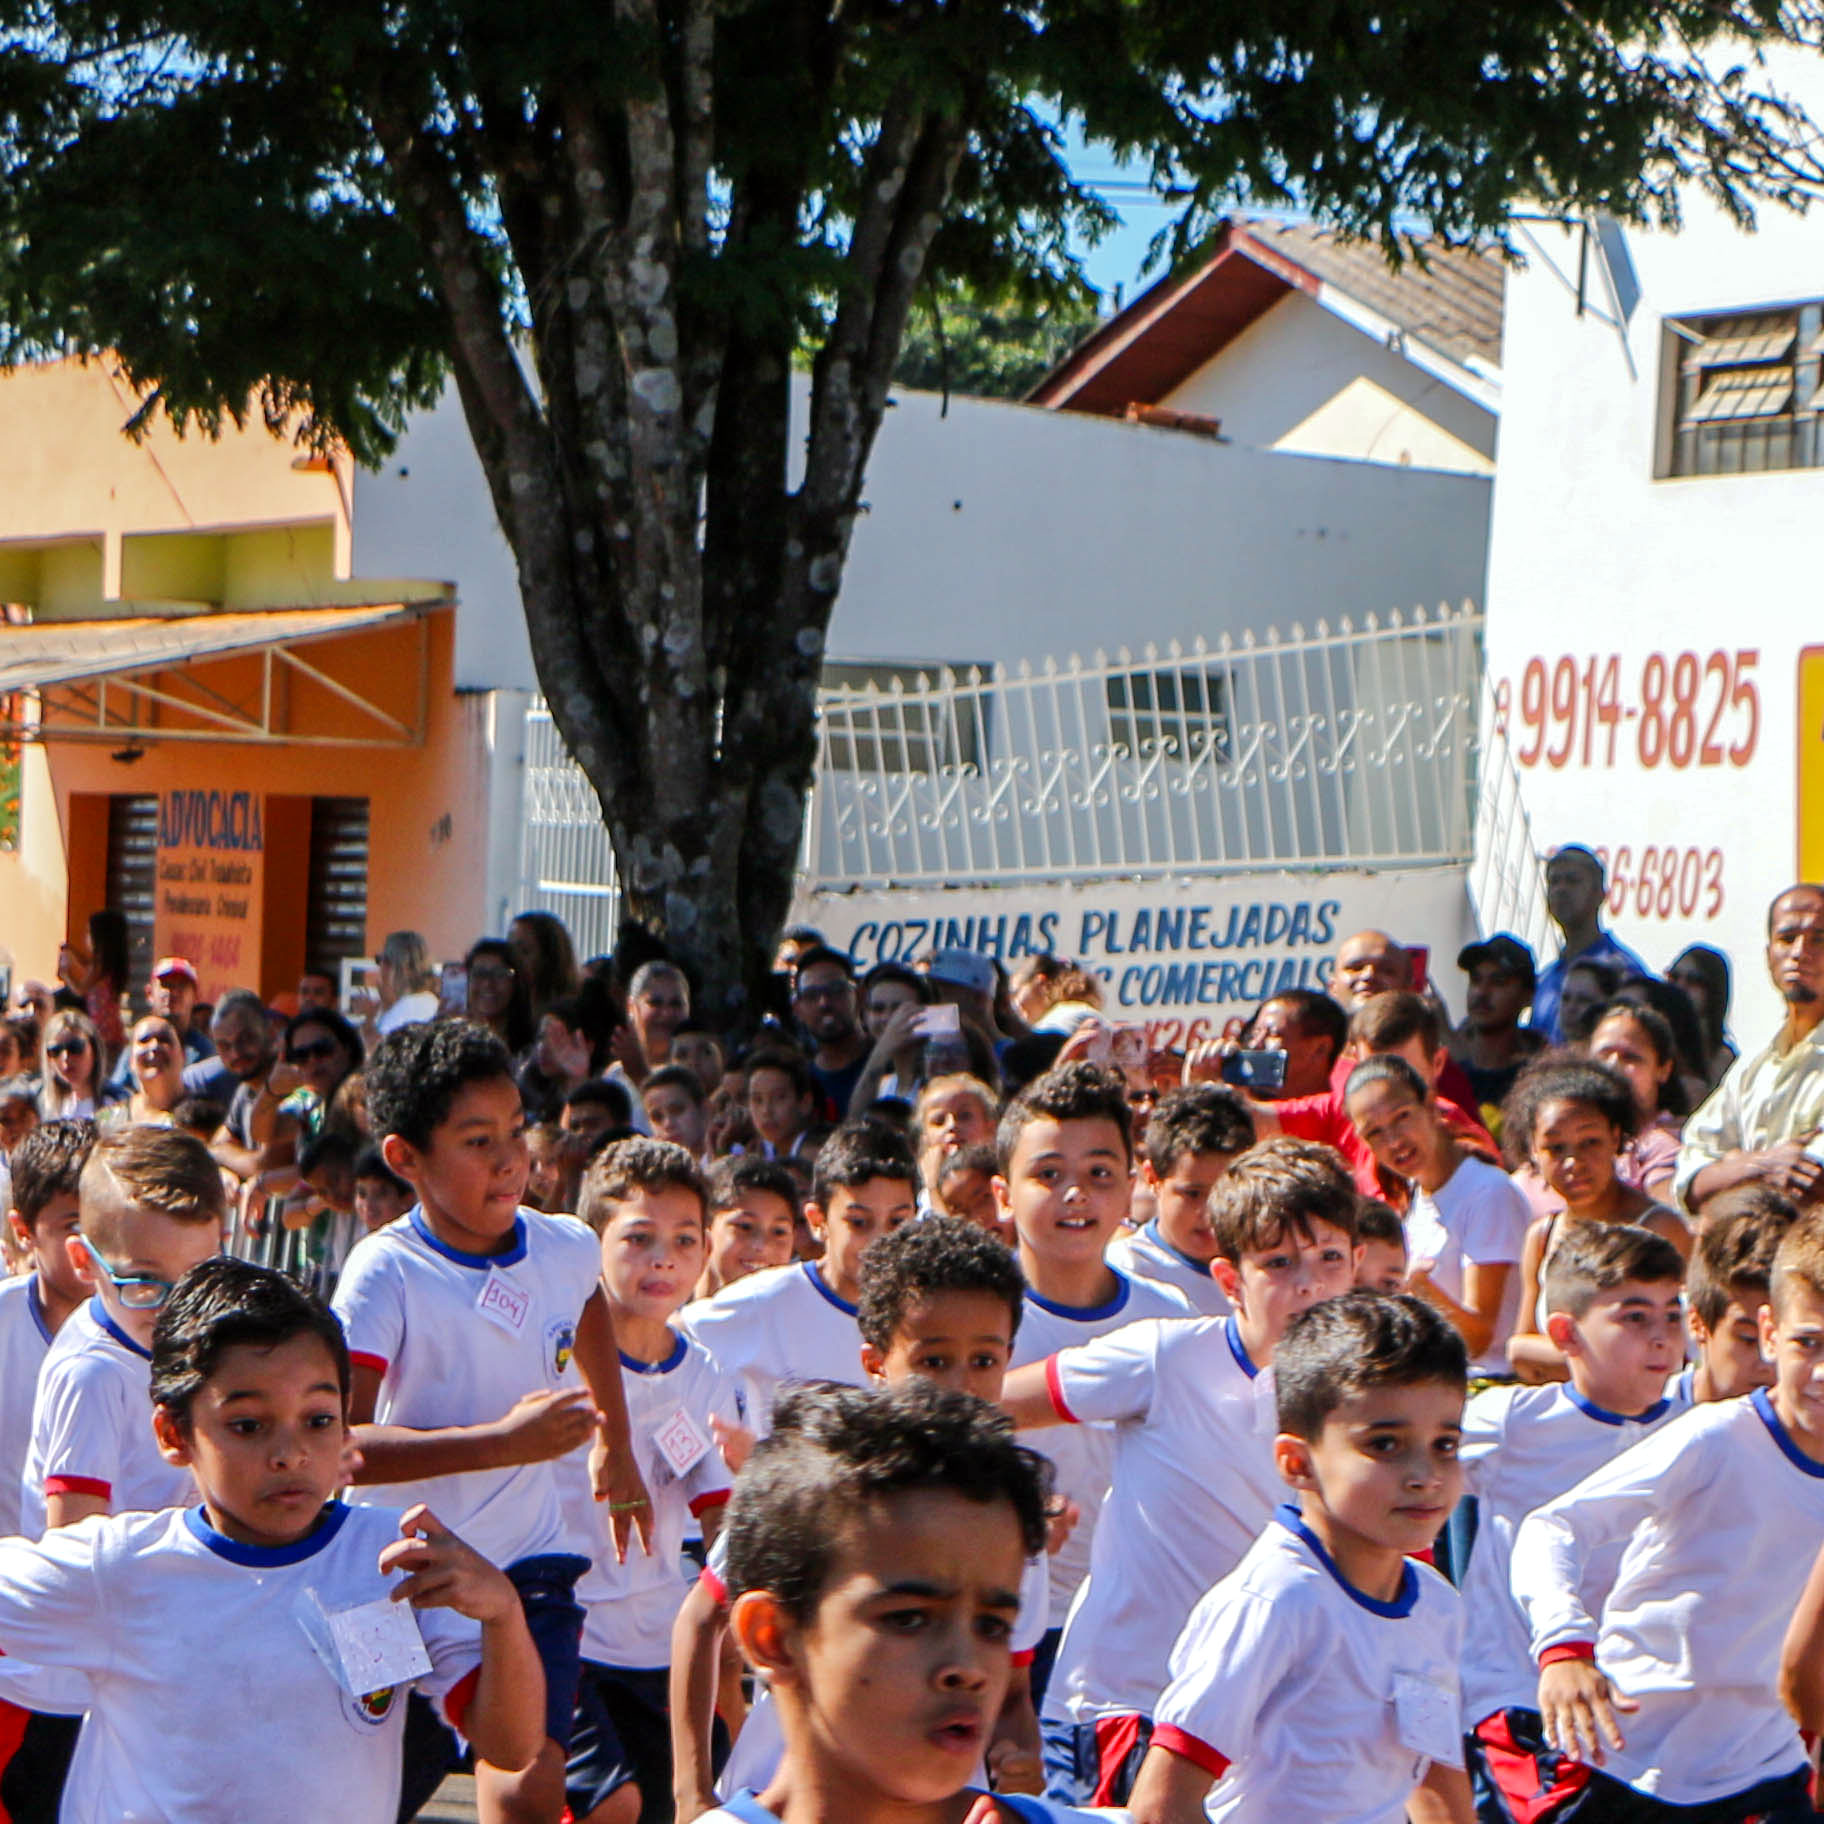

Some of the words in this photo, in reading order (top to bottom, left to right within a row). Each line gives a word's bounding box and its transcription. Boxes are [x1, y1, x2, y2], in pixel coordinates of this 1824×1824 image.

[1518, 648, 1761, 770] 9914-8825
[160, 789, 263, 851] ADVOCACIA
[849, 911, 1060, 968] COZINHAS
[1080, 900, 1341, 954] PLANEJADAS
